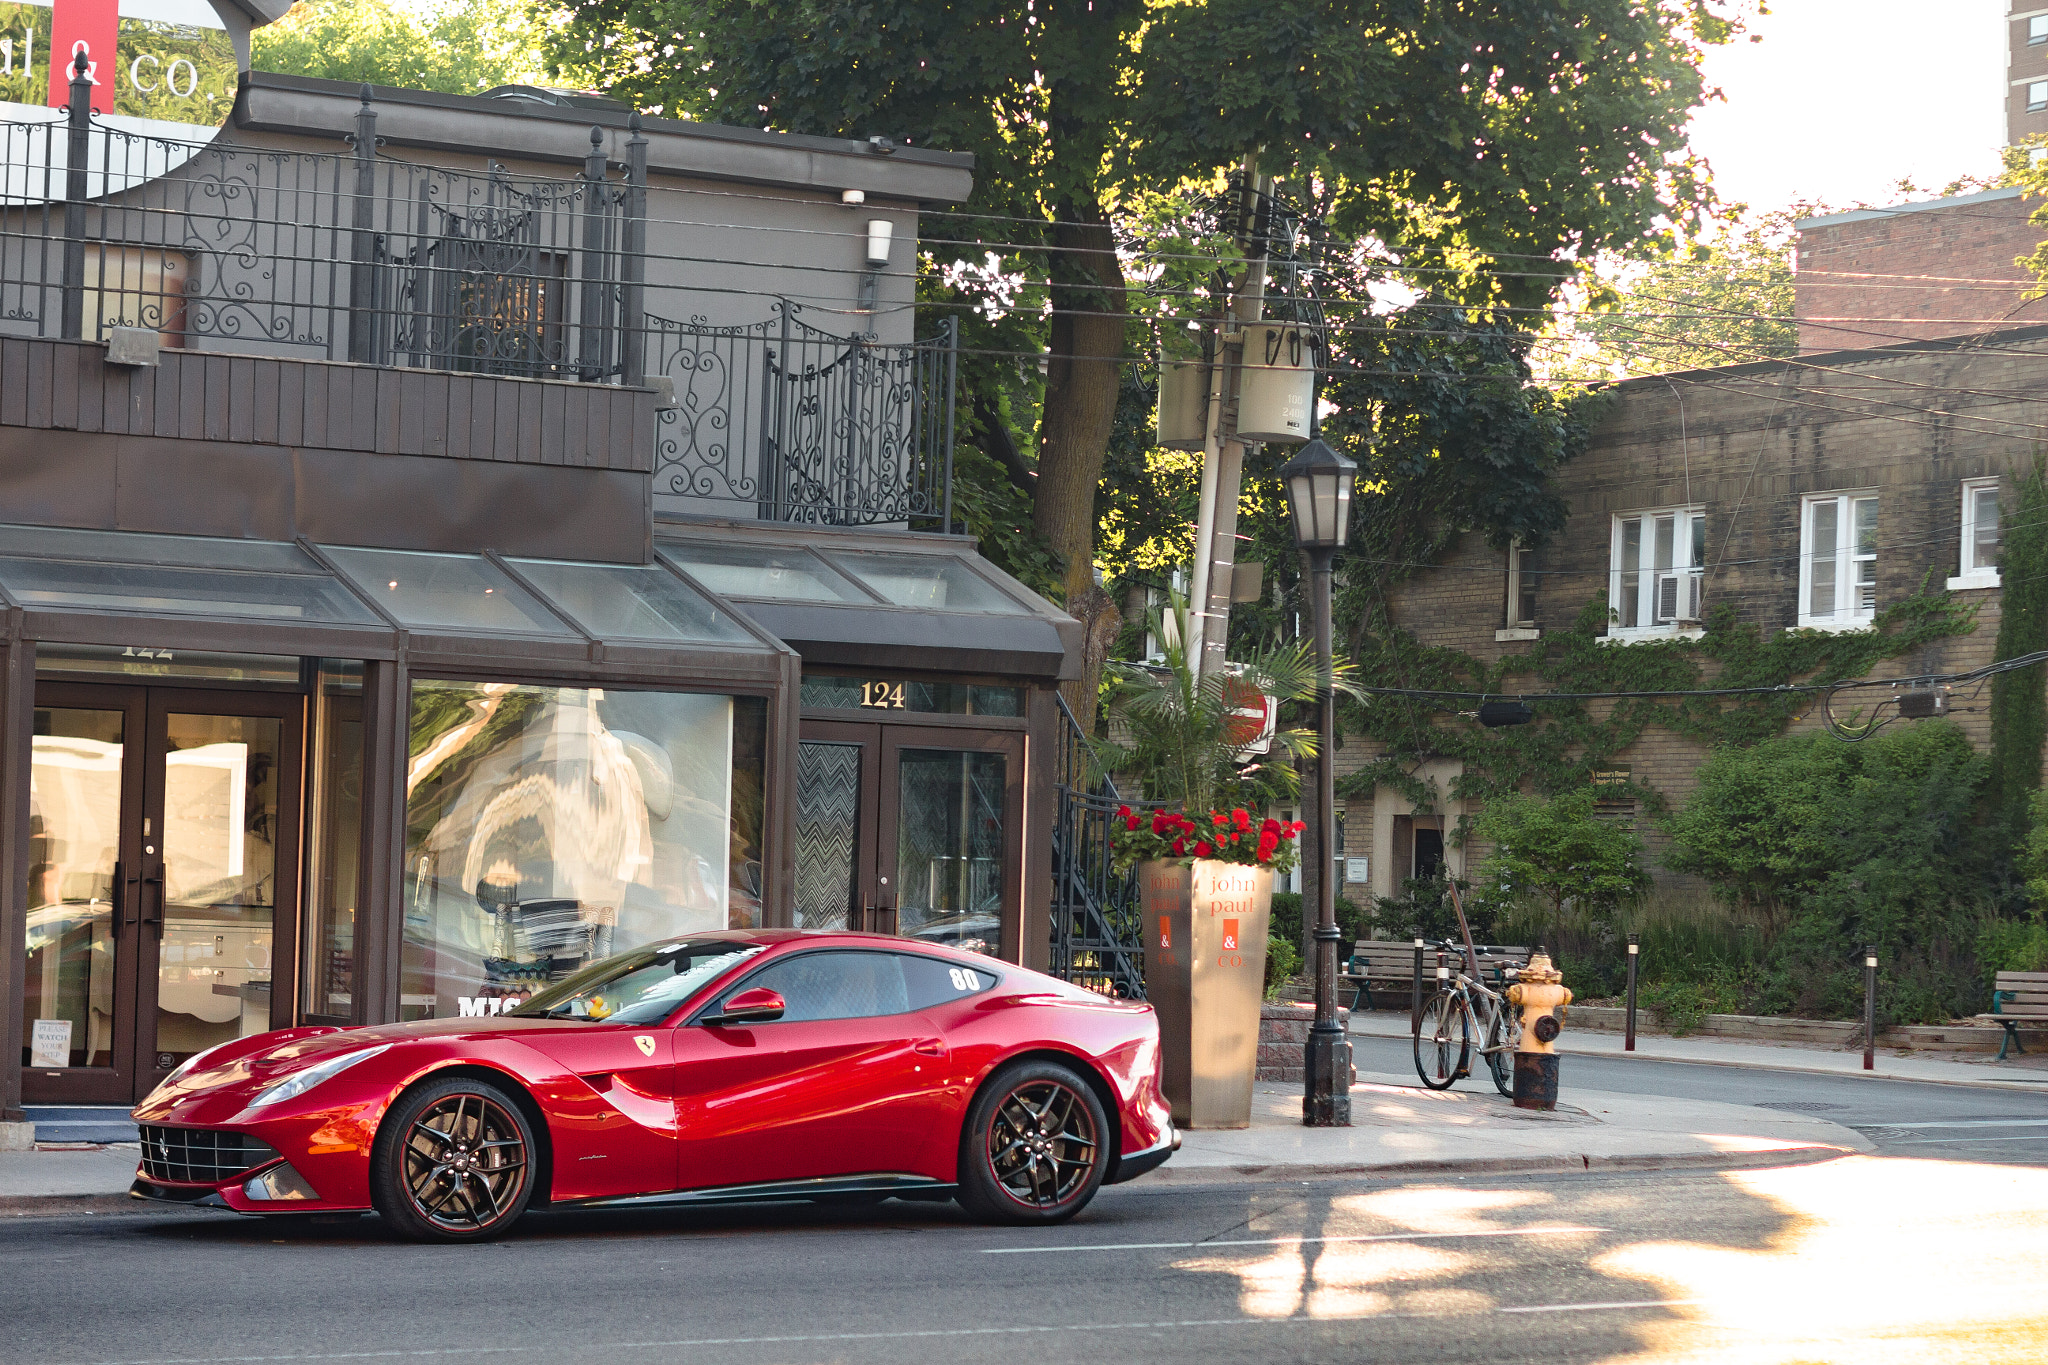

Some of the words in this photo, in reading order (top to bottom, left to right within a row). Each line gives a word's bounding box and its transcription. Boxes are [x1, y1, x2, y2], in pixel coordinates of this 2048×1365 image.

[860, 681, 905, 709] 124
[1150, 874, 1180, 894] john
[1209, 876, 1255, 895] john
[1150, 895, 1180, 914] paul
[1210, 897, 1253, 917] paul
[1161, 934, 1170, 948] &
[1224, 935, 1236, 949] &
[948, 968, 980, 991] 80
[38, 1033, 67, 1041] WATCH
